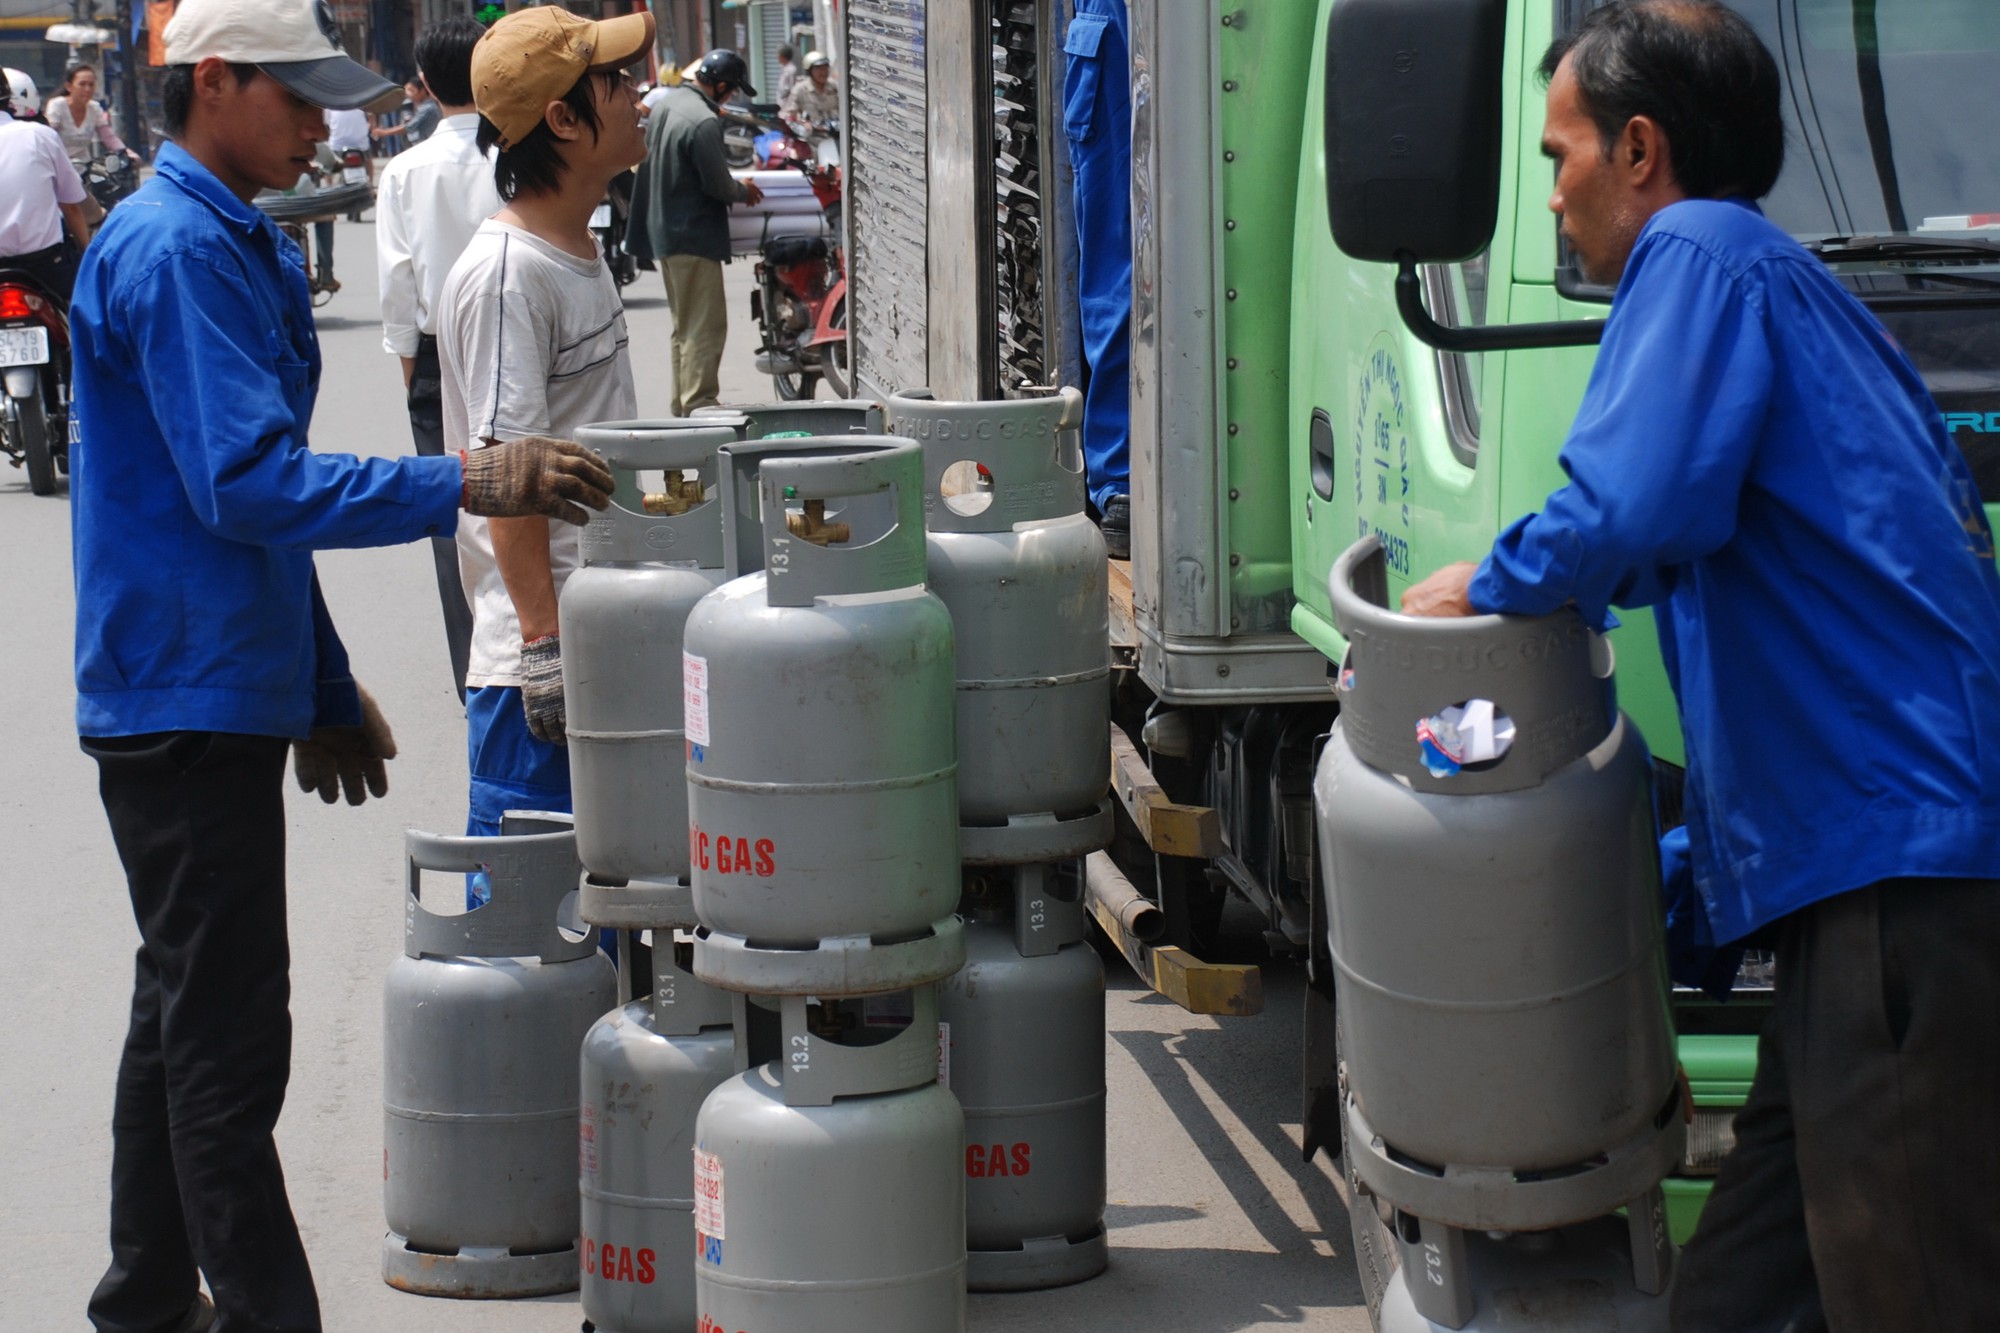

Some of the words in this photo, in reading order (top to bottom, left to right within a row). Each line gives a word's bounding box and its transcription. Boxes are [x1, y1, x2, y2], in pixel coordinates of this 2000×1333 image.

[896, 416, 931, 439] THU
[936, 419, 991, 441] DUC
[1000, 416, 1049, 440] GAS
[771, 538, 790, 576] 13.1
[1423, 643, 1508, 672] DUC
[690, 821, 709, 871] ỨC
[716, 835, 775, 878] GAS
[1030, 900, 1045, 932] 13.3
[658, 974, 675, 1007] 13.1
[791, 1036, 809, 1073] 13.2
[964, 1142, 1031, 1179] GAS
[602, 1243, 656, 1285] GAS
[1423, 1242, 1443, 1287] 13.2
